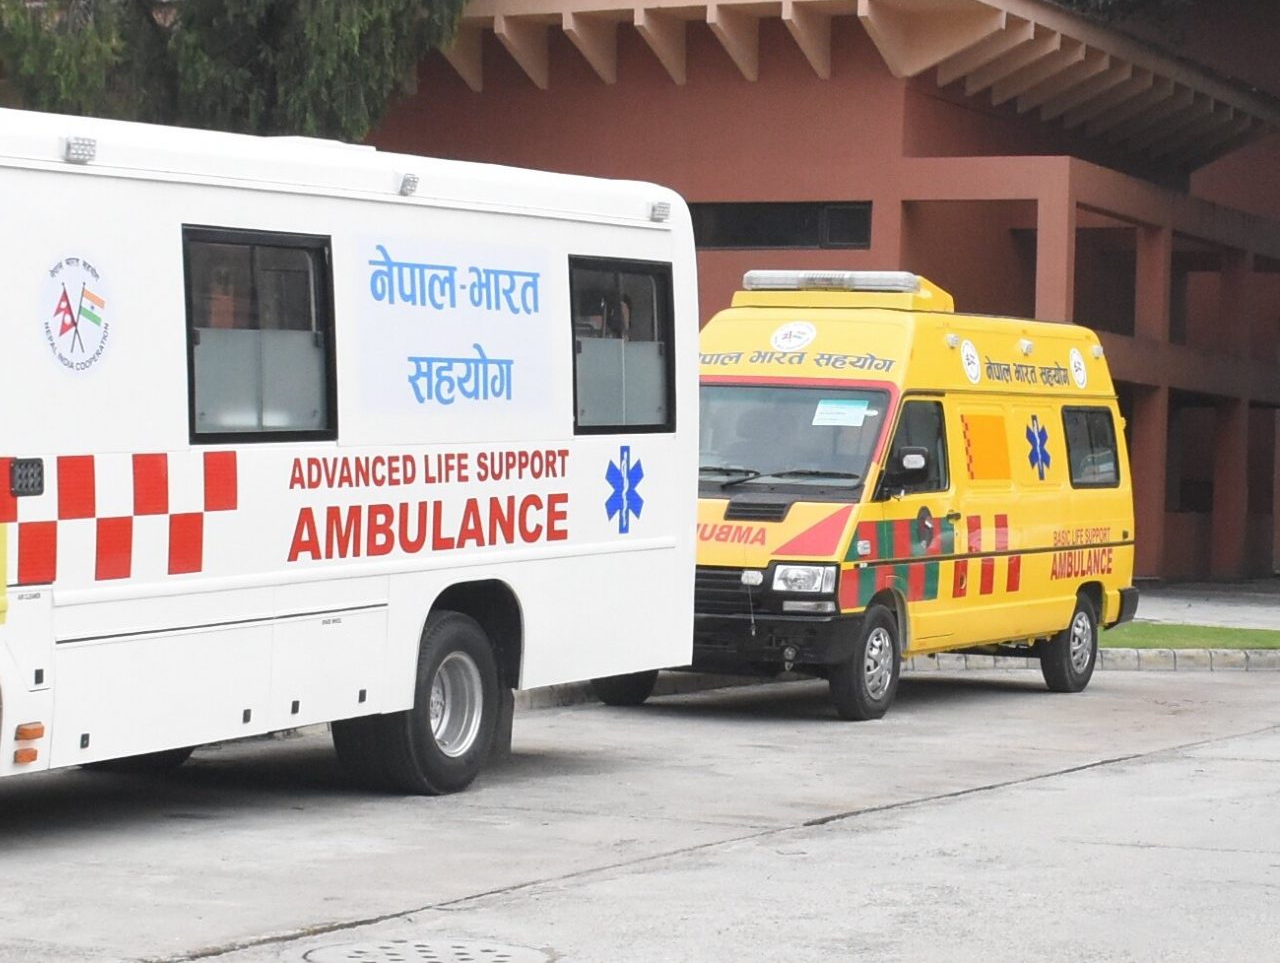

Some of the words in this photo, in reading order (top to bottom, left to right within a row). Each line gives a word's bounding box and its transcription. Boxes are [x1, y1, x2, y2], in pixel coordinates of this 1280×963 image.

[368, 244, 540, 315] नेपाल-भारत
[407, 343, 514, 405] सहयोग
[698, 351, 745, 367] पाल
[749, 350, 808, 366] भारत
[813, 352, 896, 373] सहयोग
[984, 355, 1012, 383] नेपाल
[1013, 363, 1037, 385] भारत
[1038, 361, 1070, 386] सहयोग
[289, 455, 417, 489] ADVANCED
[424, 453, 469, 484] LIFE
[476, 449, 569, 482] SUPPORT
[287, 493, 569, 562] AMBULANCE
[1053, 530, 1071, 547] BASIC
[1071, 528, 1084, 545] LIFE
[1085, 526, 1111, 544] SUPPORT
[1050, 547, 1113, 580] AMBULANCE
